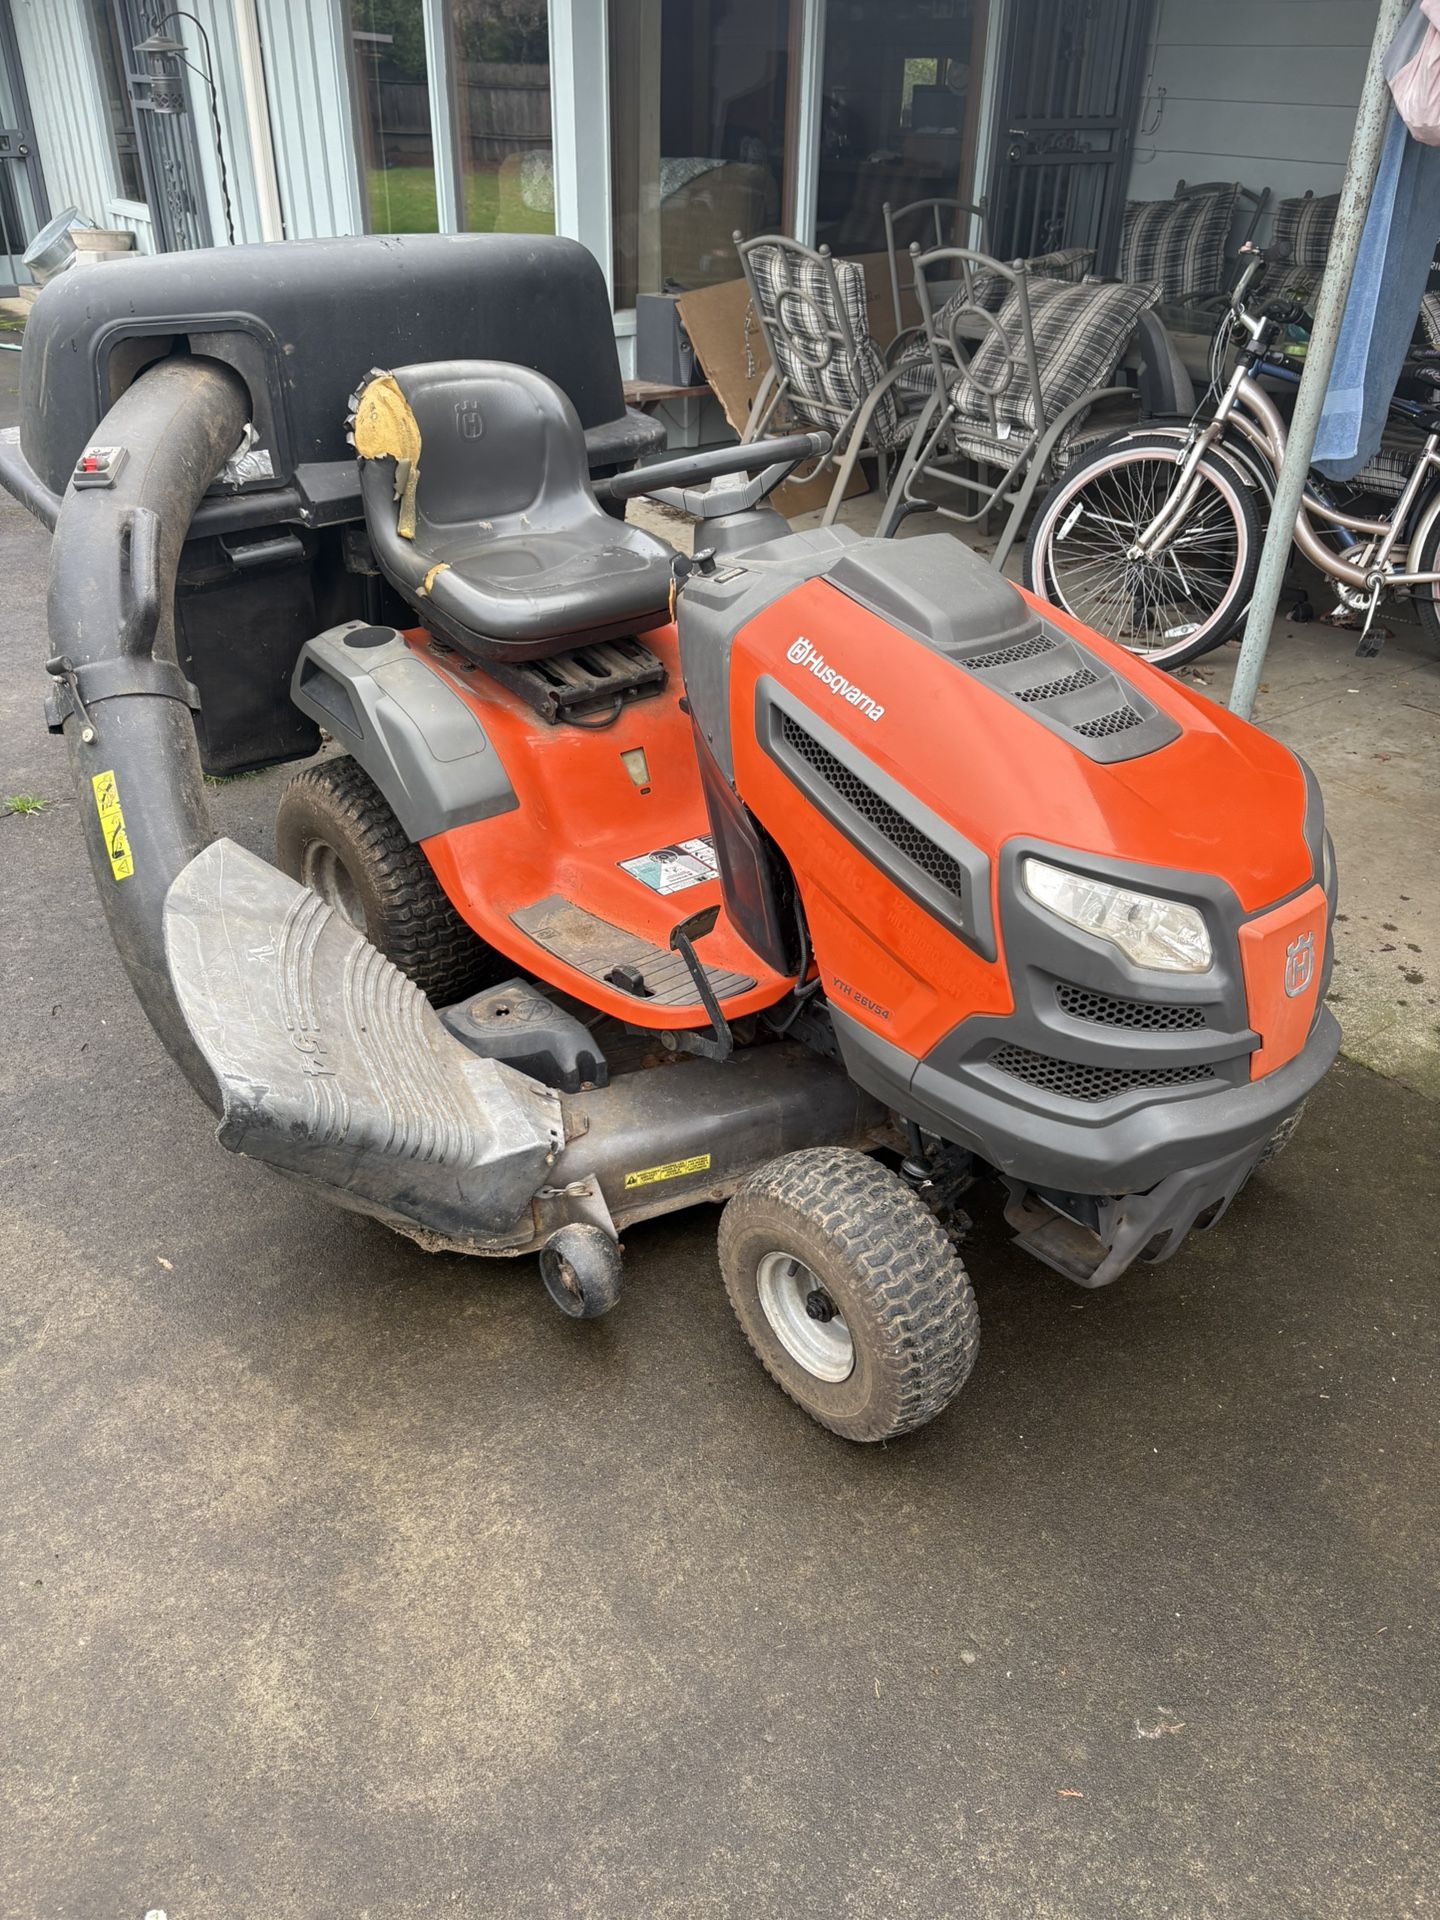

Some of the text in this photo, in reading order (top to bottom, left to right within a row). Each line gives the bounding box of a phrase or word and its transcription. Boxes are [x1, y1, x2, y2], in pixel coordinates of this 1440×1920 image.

[801, 648, 886, 722] Husqvarna
[833, 976, 890, 1019] YTH 26V54
